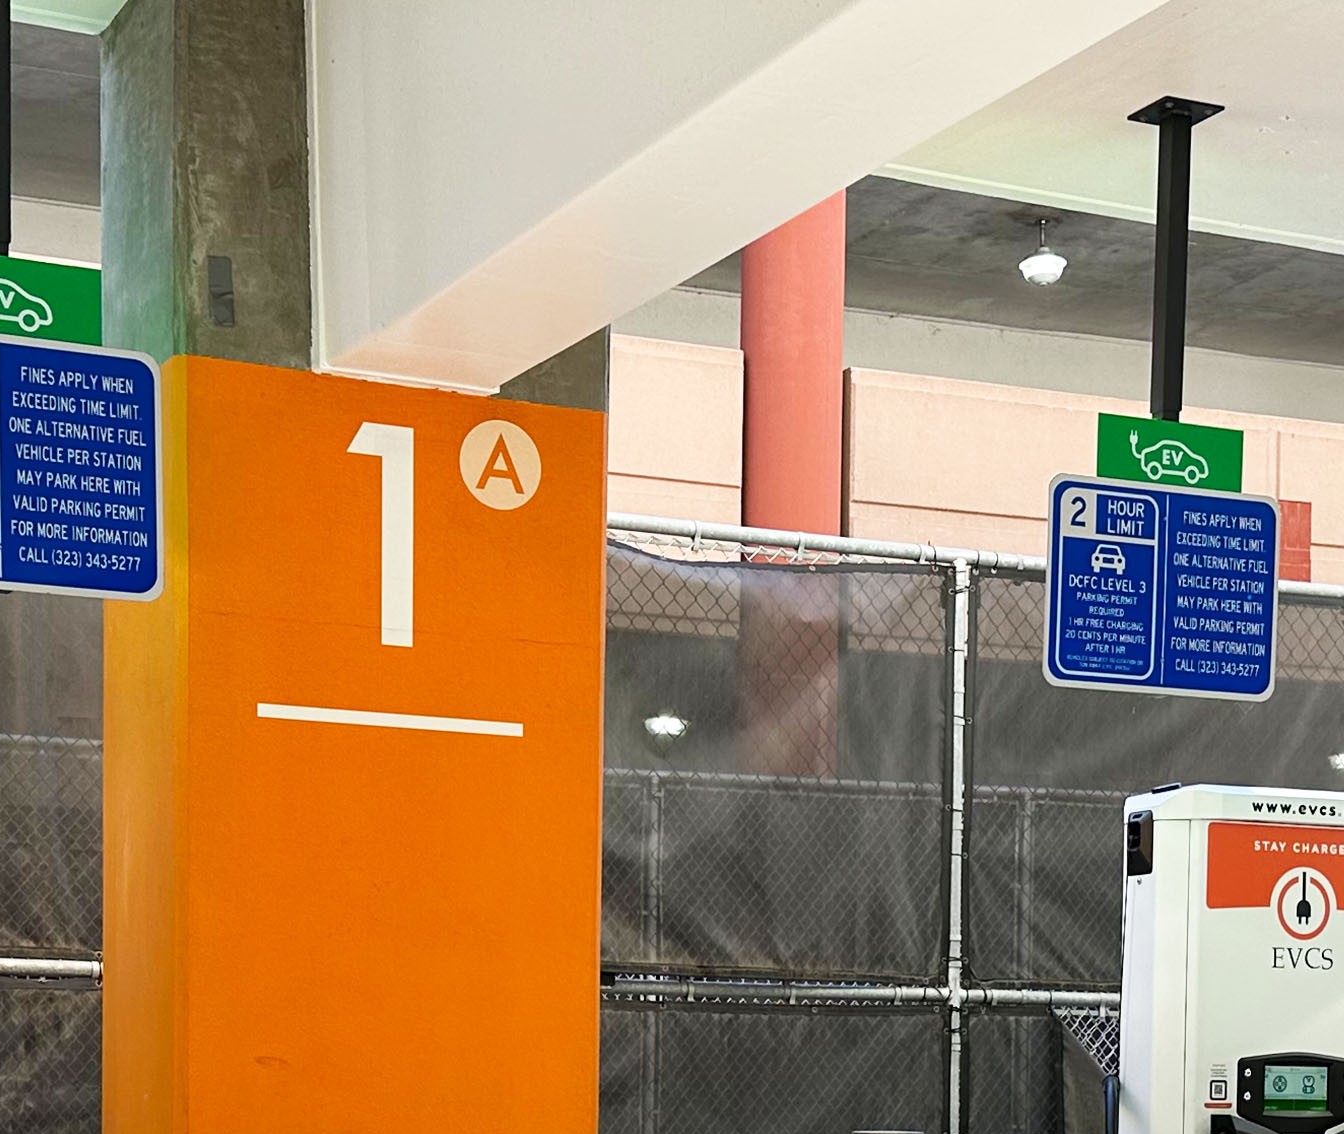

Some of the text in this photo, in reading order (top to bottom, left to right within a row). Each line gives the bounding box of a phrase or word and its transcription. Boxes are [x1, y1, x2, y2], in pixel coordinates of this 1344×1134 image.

[21, 366, 133, 394] FINES APPLY WHEN
[12, 391, 76, 413] EXCEEDING
[80, 398, 106, 416] TIME
[9, 416, 147, 447] ONE ALTERNATIVE FUEL
[15, 443, 142, 471] VEHICLE PER STATION
[1162, 449, 1183, 466] EV
[17, 469, 141, 497] MAY PARK HERE WITH
[13, 494, 145, 522] VALID PARKING PERMIT
[1070, 496, 1086, 527] 2
[1108, 499, 1144, 518] HOUR
[1107, 518, 1144, 536] LIMIT
[1183, 511, 1261, 531] FINES APPLY WHEN
[11, 520, 148, 547] FOR MORE INFORMATION
[346, 421, 525, 647] 1 A
[1176, 531, 1221, 549] EXCEEDING
[1223, 536, 1242, 551] TIME
[19, 546, 141, 572] CALL (323) 343-5277
[1173, 552, 1268, 574] ONE ALTERNATIVE FUEL
[1069, 574, 1146, 593] DCFC LEVEL 3
[1177, 573, 1264, 594] VEHICLE PER STATION
[1177, 595, 1262, 615] MAY PARK HERE WITH
[1173, 616, 1265, 636] VALID PARKING PERMIT
[1171, 636, 1265, 657] FOR MORE INFORMATION
[1176, 658, 1259, 677] CALL (323) 343-5277
[1254, 840, 1286, 852] STAY
[1271, 947, 1334, 970] EVCS
